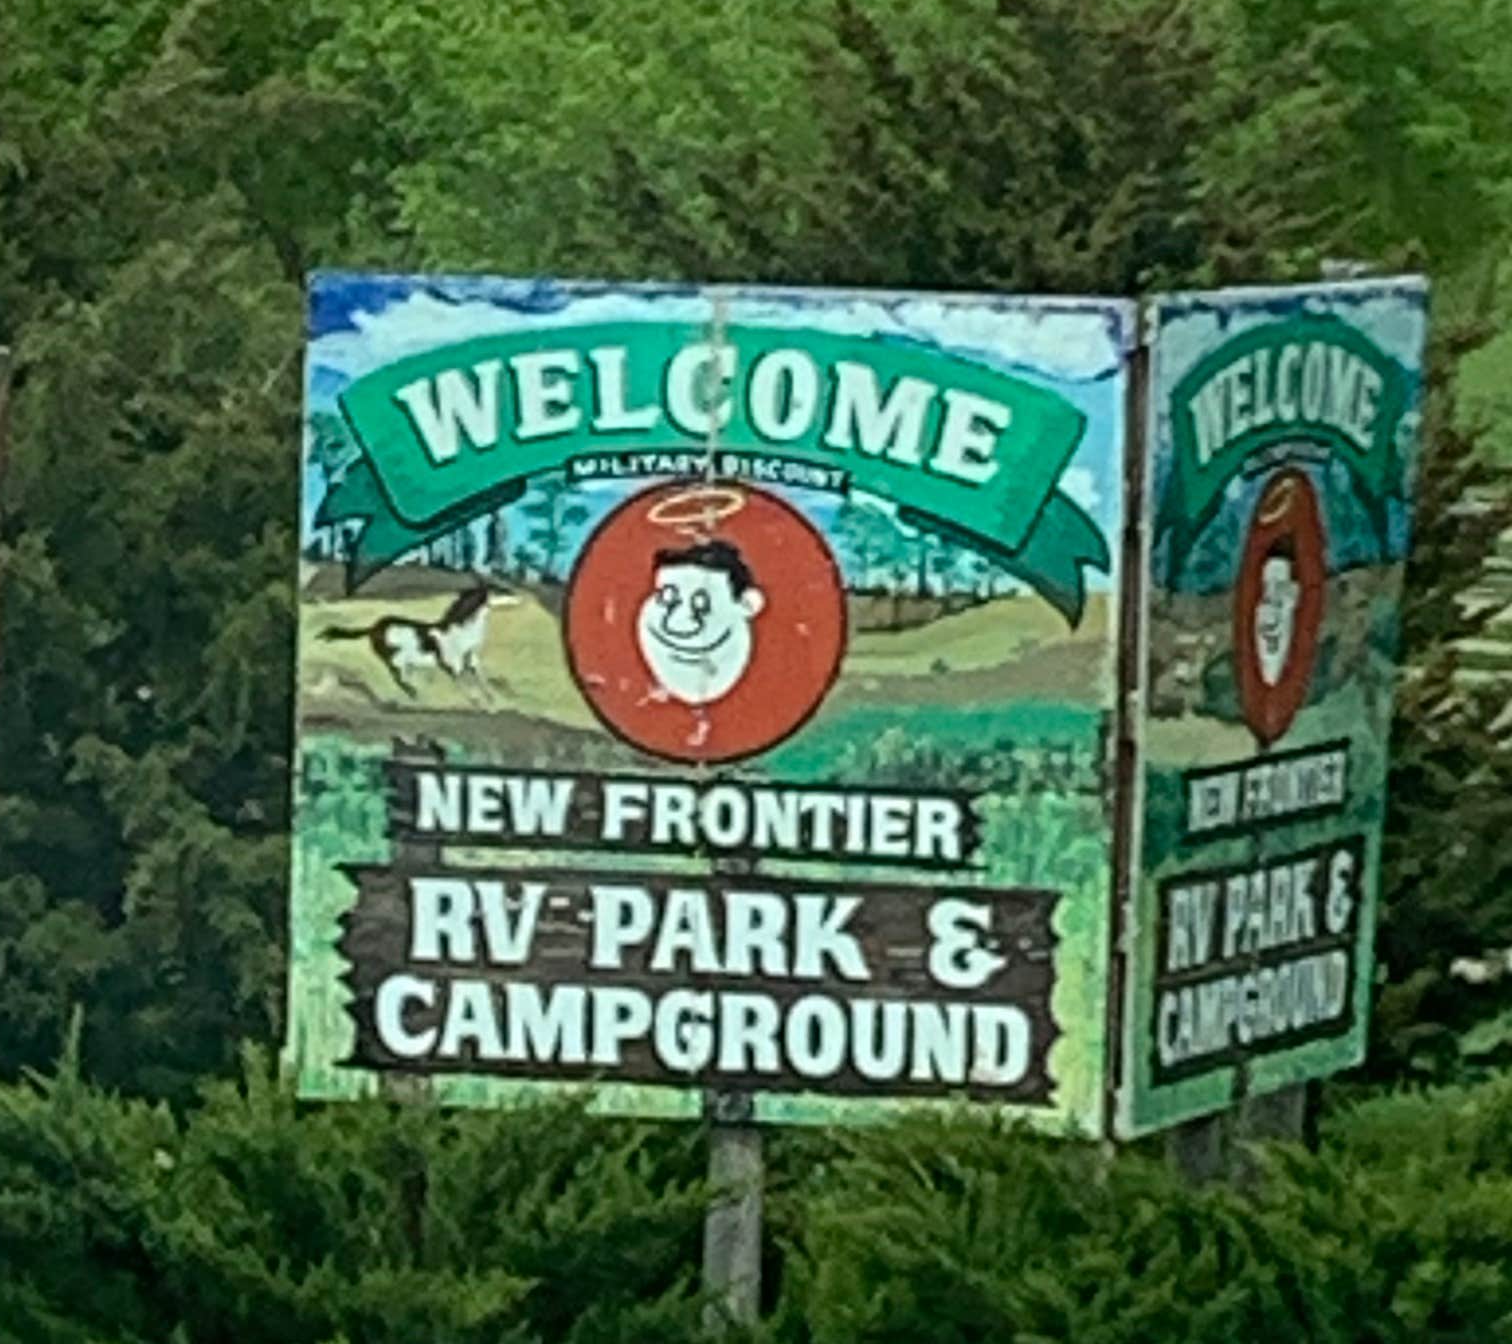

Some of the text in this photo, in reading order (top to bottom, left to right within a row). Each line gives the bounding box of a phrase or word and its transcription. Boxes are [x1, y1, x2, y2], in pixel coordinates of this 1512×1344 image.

[396, 344, 1013, 486] WELCOME
[1191, 341, 1382, 465] WELCOME
[416, 772, 963, 860] NEW FRONTIER
[409, 877, 1008, 988] RV PARK &
[1222, 859, 1319, 958] PARK
[373, 974, 1032, 1086] CAMPGROUND
